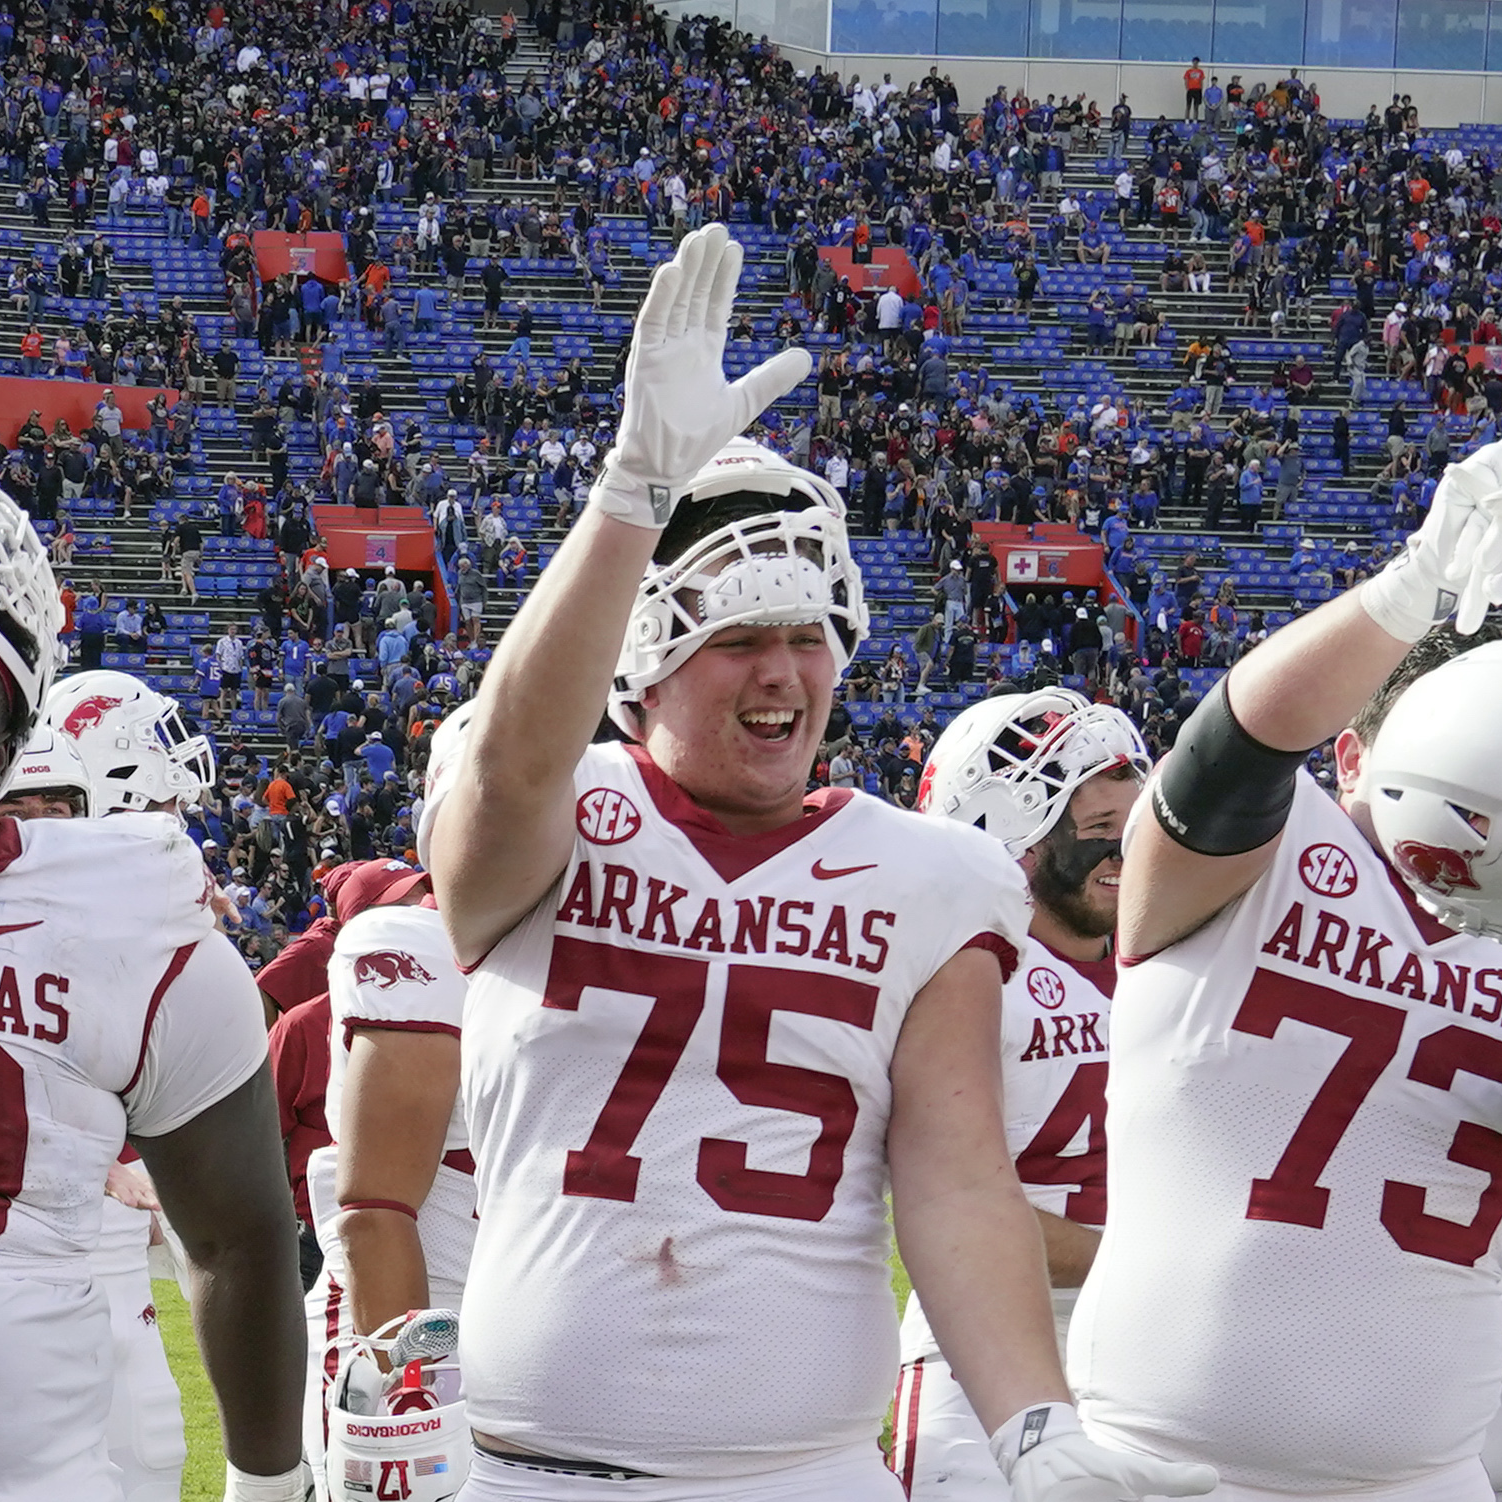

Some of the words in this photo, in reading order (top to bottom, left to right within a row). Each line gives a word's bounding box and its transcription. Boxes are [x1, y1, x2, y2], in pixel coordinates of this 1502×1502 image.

[375, 546, 386, 558] 4
[1048, 561, 1059, 575] 6
[209, 667, 221, 680] 15
[439, 677, 453, 691] 15
[22, 765, 51, 775] HOGS
[581, 793, 638, 843] SEC
[1302, 847, 1356, 896] SEC
[556, 860, 897, 973] ARKANSAS
[1030, 970, 1064, 1007] SEC
[1020, 1012, 1109, 1062] ARK
[542, 935, 881, 1222] 75
[346, 1417, 442, 1438] RAZORBACKS
[376, 1459, 412, 1502] 17
